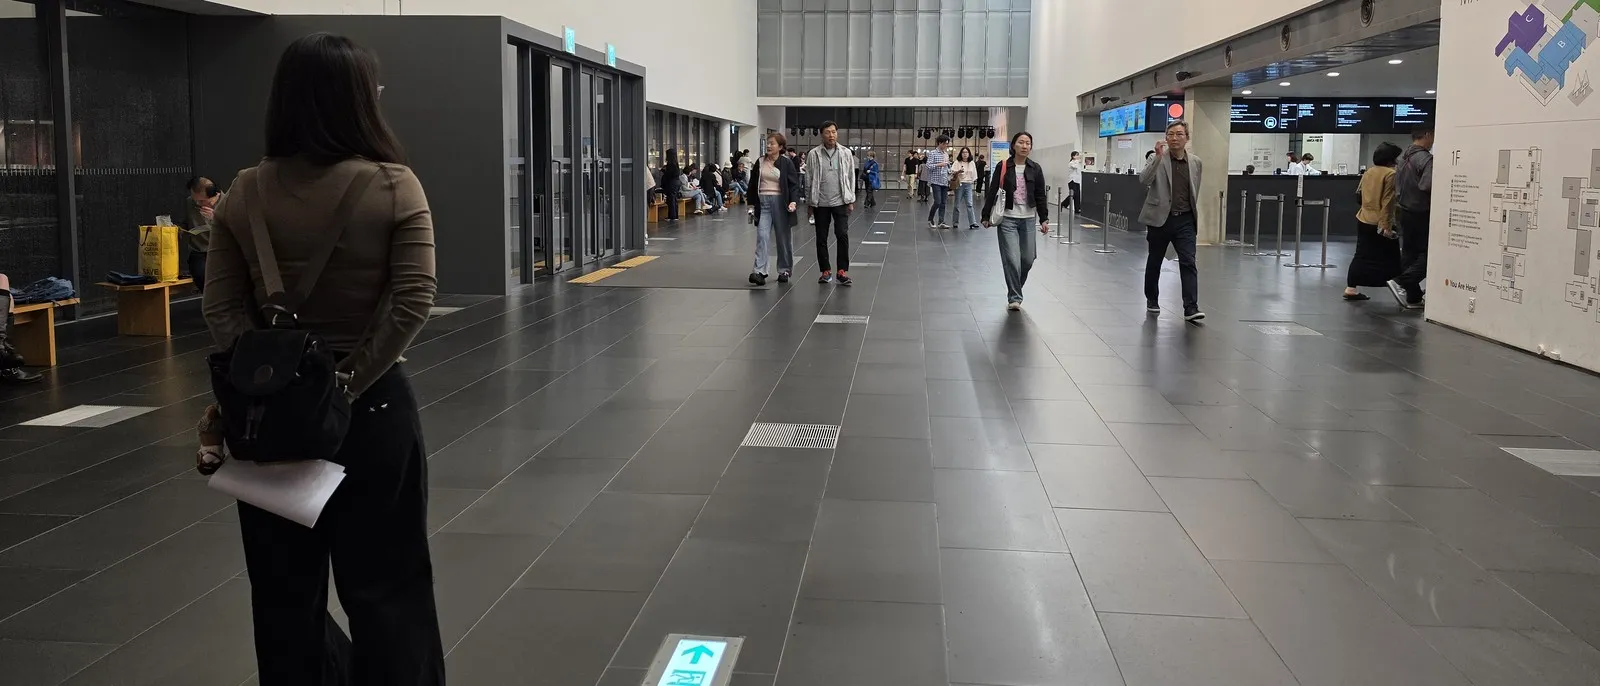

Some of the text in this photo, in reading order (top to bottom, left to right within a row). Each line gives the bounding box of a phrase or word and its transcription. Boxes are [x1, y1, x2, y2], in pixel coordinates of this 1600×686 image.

[1526, 14, 1534, 23] C
[1557, 40, 1566, 48] B
[1452, 150, 1461, 166] 1F
